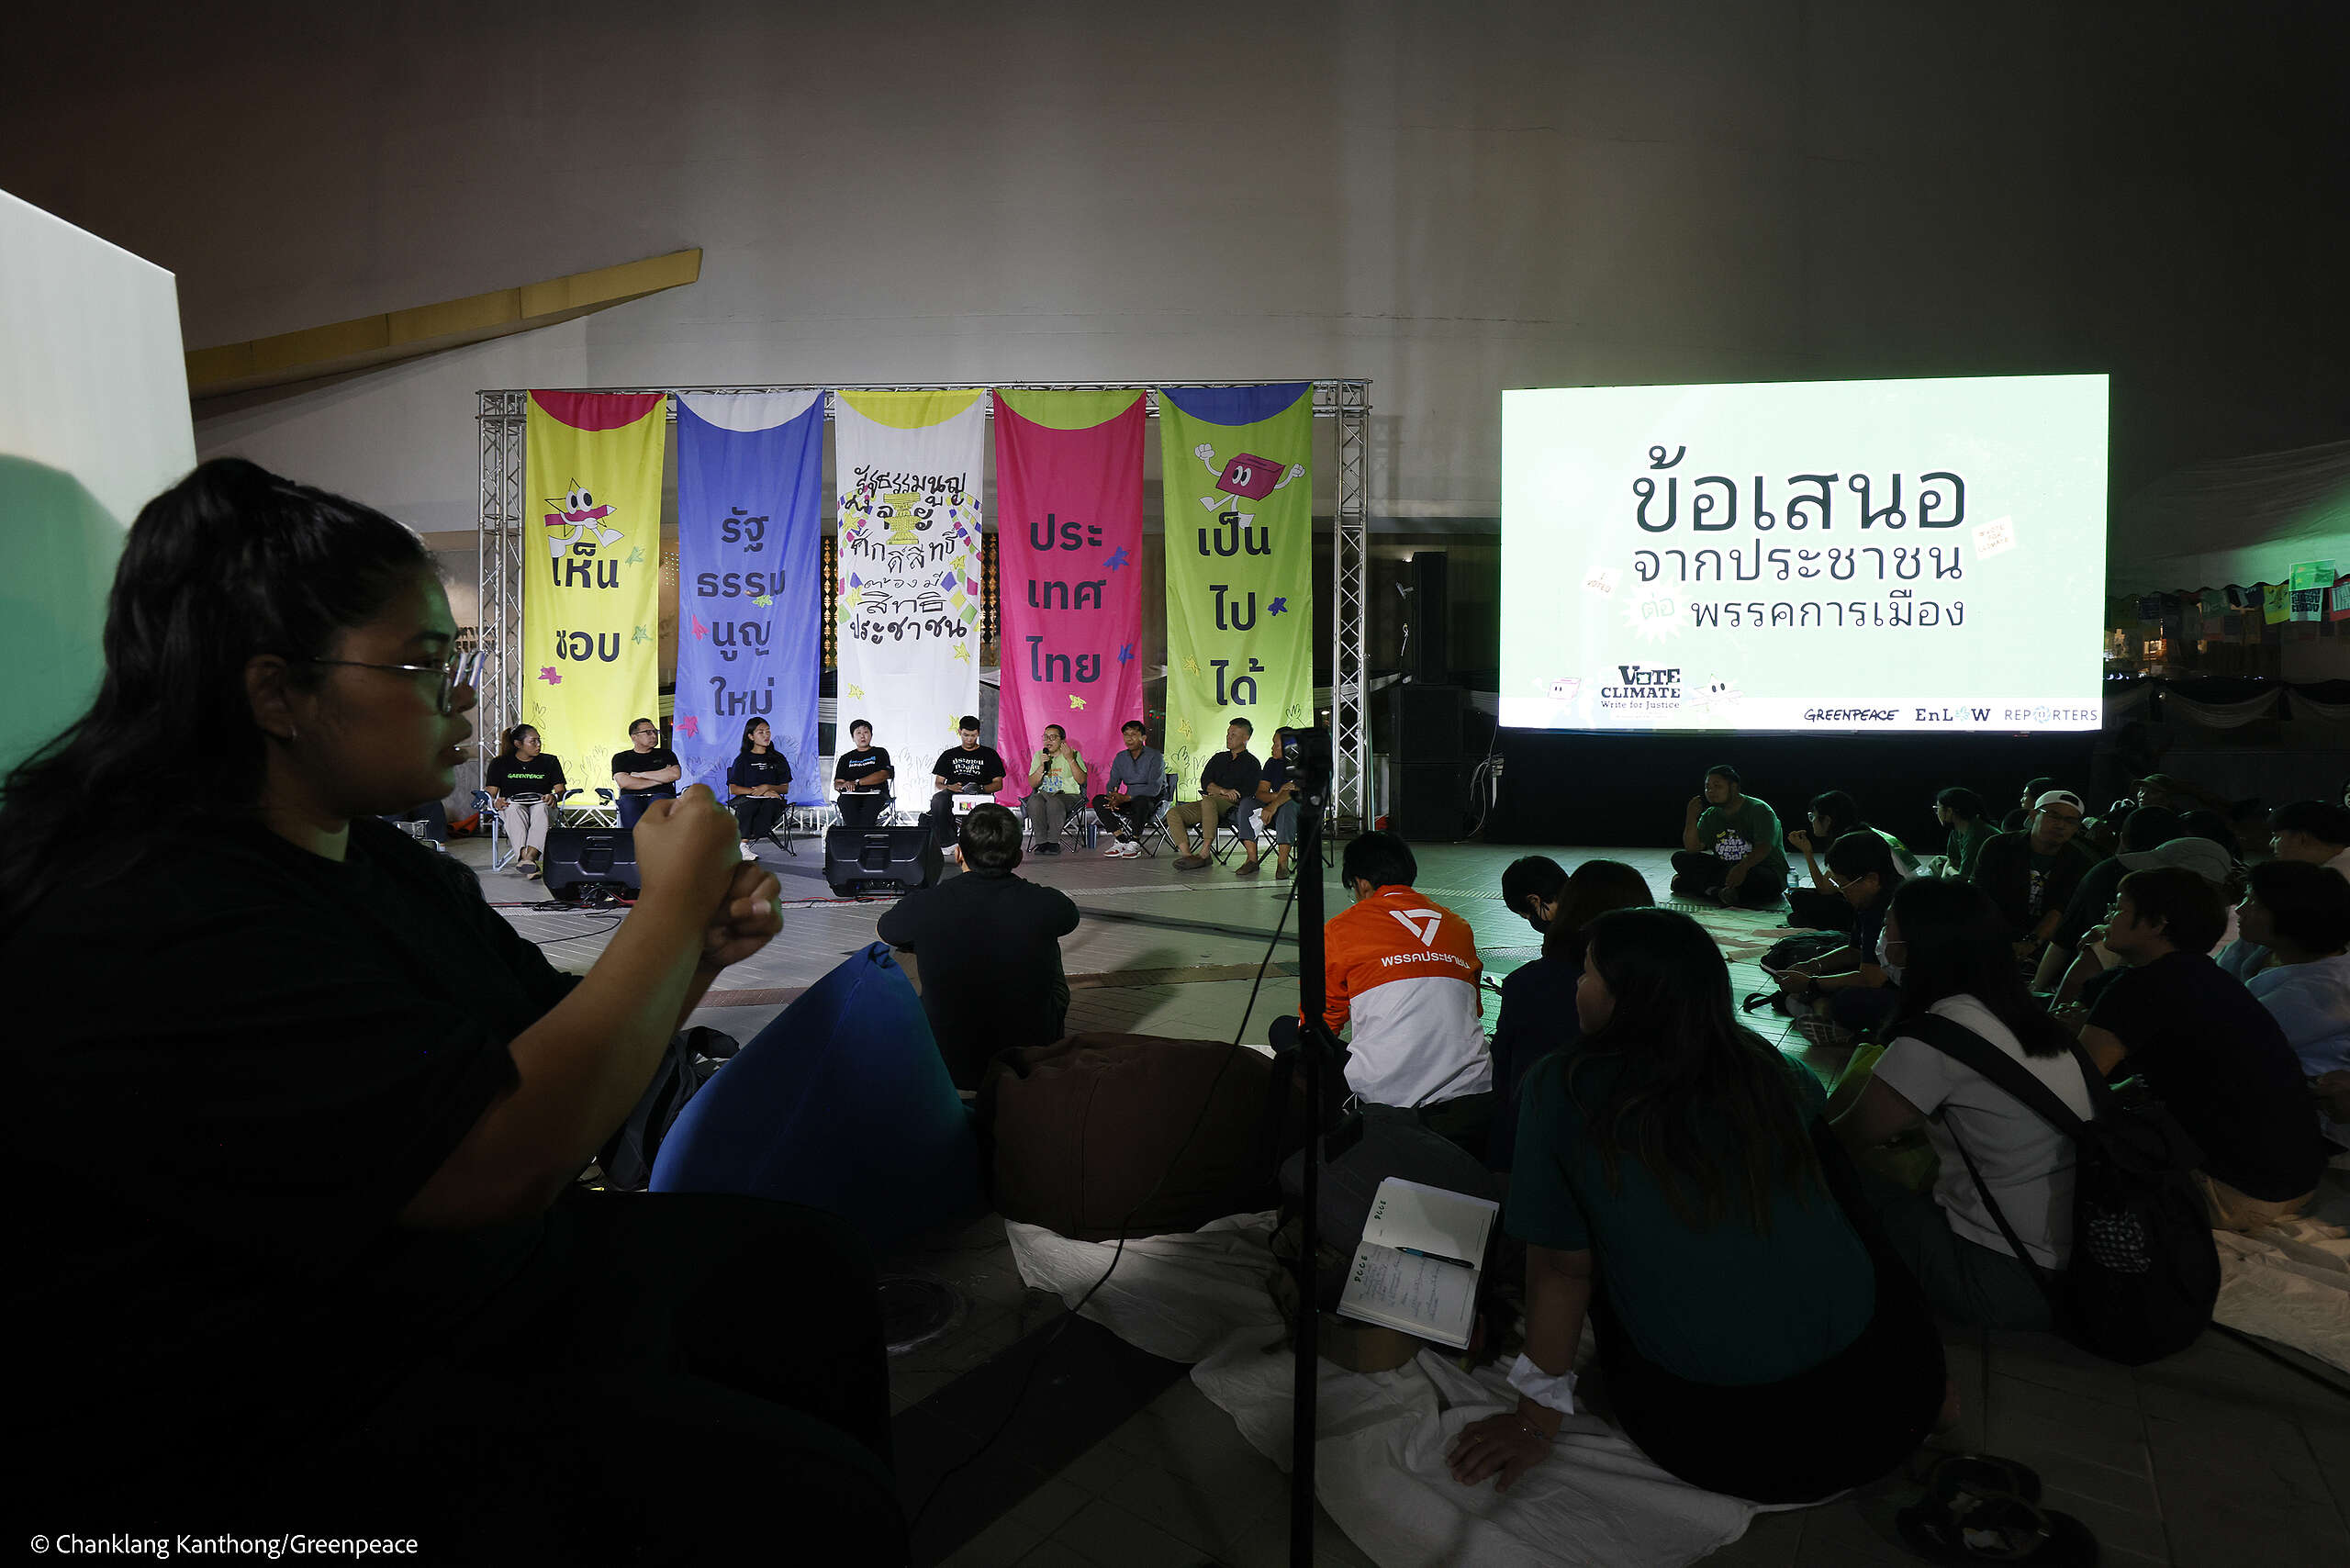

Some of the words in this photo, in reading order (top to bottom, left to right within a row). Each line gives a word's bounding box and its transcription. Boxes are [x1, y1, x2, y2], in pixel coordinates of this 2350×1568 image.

[1632, 445, 1965, 532] ข้อเสนอ
[721, 506, 769, 553] รัฐ
[1029, 512, 1102, 552] ประ
[1198, 511, 1271, 557] เป็น
[552, 542, 619, 589] เห็น
[1634, 538, 1963, 582] จากประชาชน
[697, 570, 786, 599] ธรรม
[1027, 578, 1107, 610] เทศ
[849, 613, 968, 644] ประชาชน
[1209, 584, 1257, 632] ไป
[1690, 588, 1964, 628] พรรคการเมือง
[711, 620, 771, 662] นูญ
[1025, 635, 1101, 684] ไทย
[710, 676, 775, 717] ใหม่
[1210, 657, 1265, 706] ได้
[1601, 688, 1681, 699] CLIMATE
[1601, 700, 1627, 709] Write
[1630, 700, 1643, 709] for
[1646, 700, 1680, 711] Justice
[1805, 709, 1899, 722] GREENPEACE
